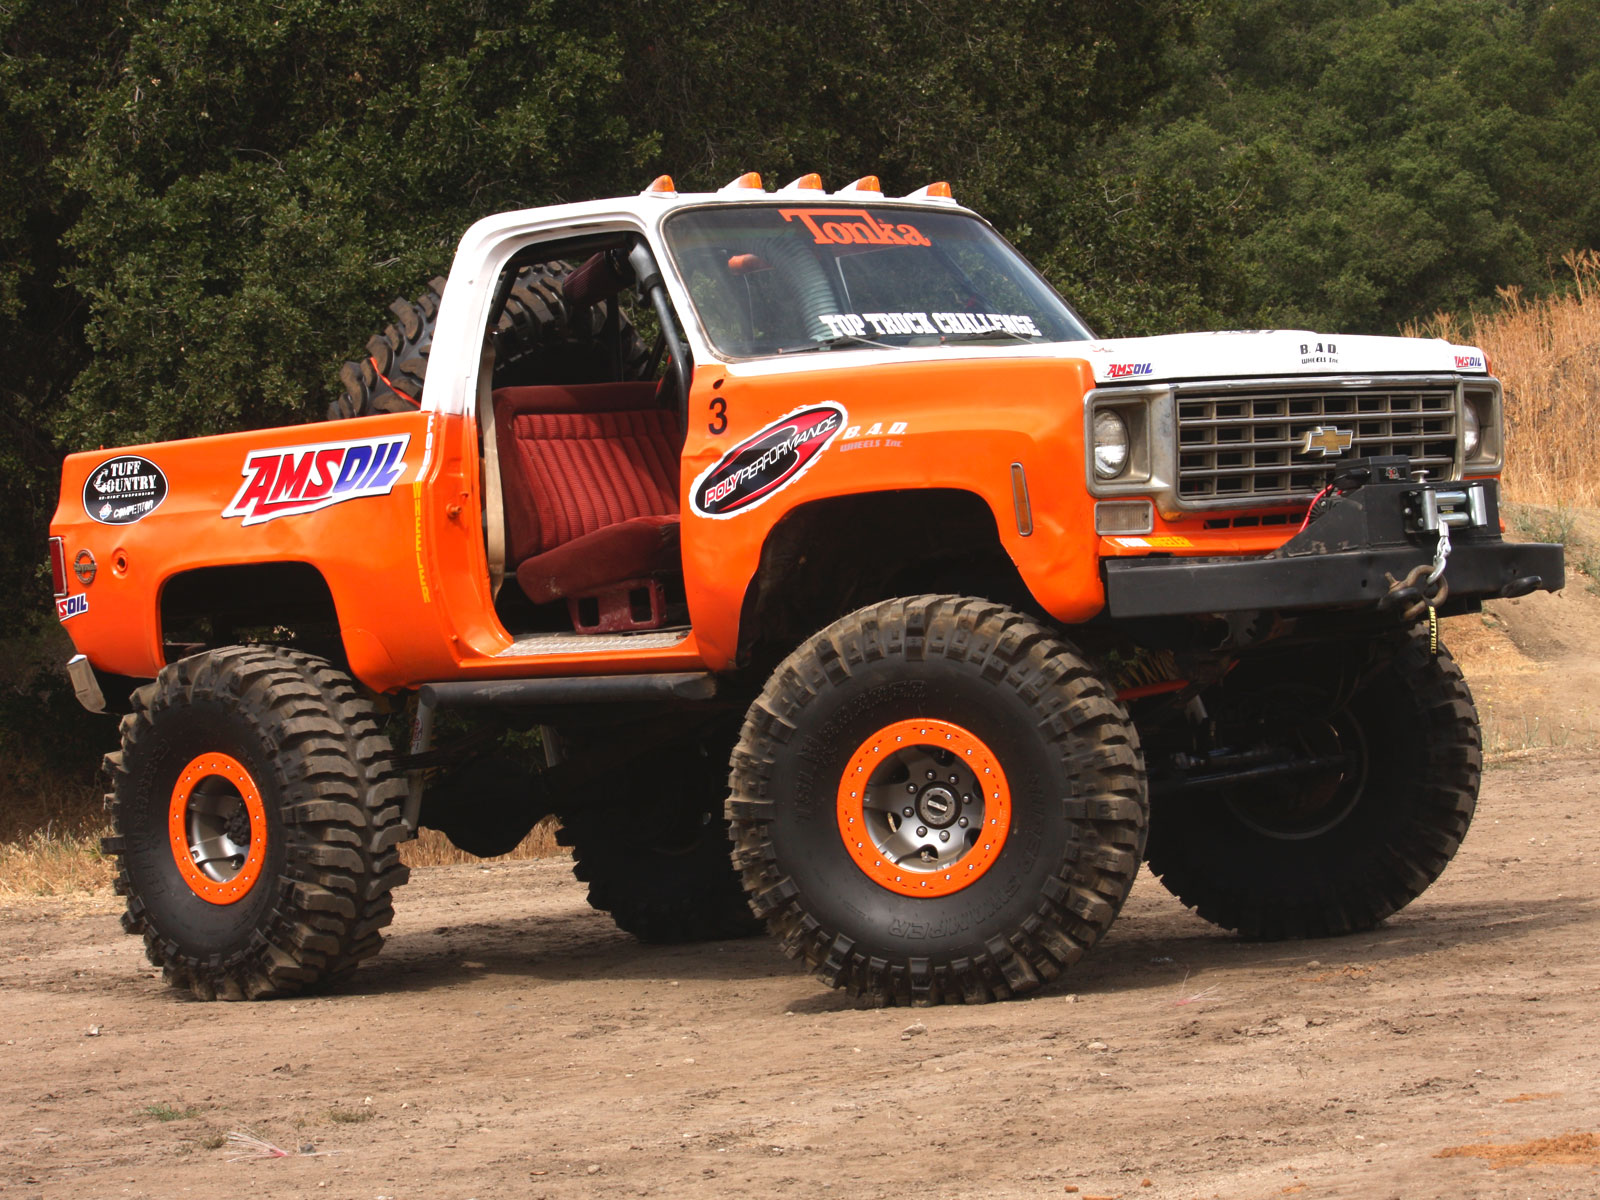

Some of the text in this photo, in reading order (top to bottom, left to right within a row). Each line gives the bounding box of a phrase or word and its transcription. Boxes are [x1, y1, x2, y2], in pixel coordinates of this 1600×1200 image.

[777, 208, 932, 247] Tonka
[819, 312, 1043, 337] TOP TRUCK CHALLENGE
[1106, 362, 1153, 378] AMSOIL
[708, 397, 728, 435] 3
[840, 439, 880, 452] WHEELS
[93, 469, 157, 493] COUNTRY
[111, 461, 141, 477] TUFF
[233, 441, 404, 518] AMSOIL
[412, 481, 431, 603] WHEELER
[56, 595, 87, 617] SOIL
